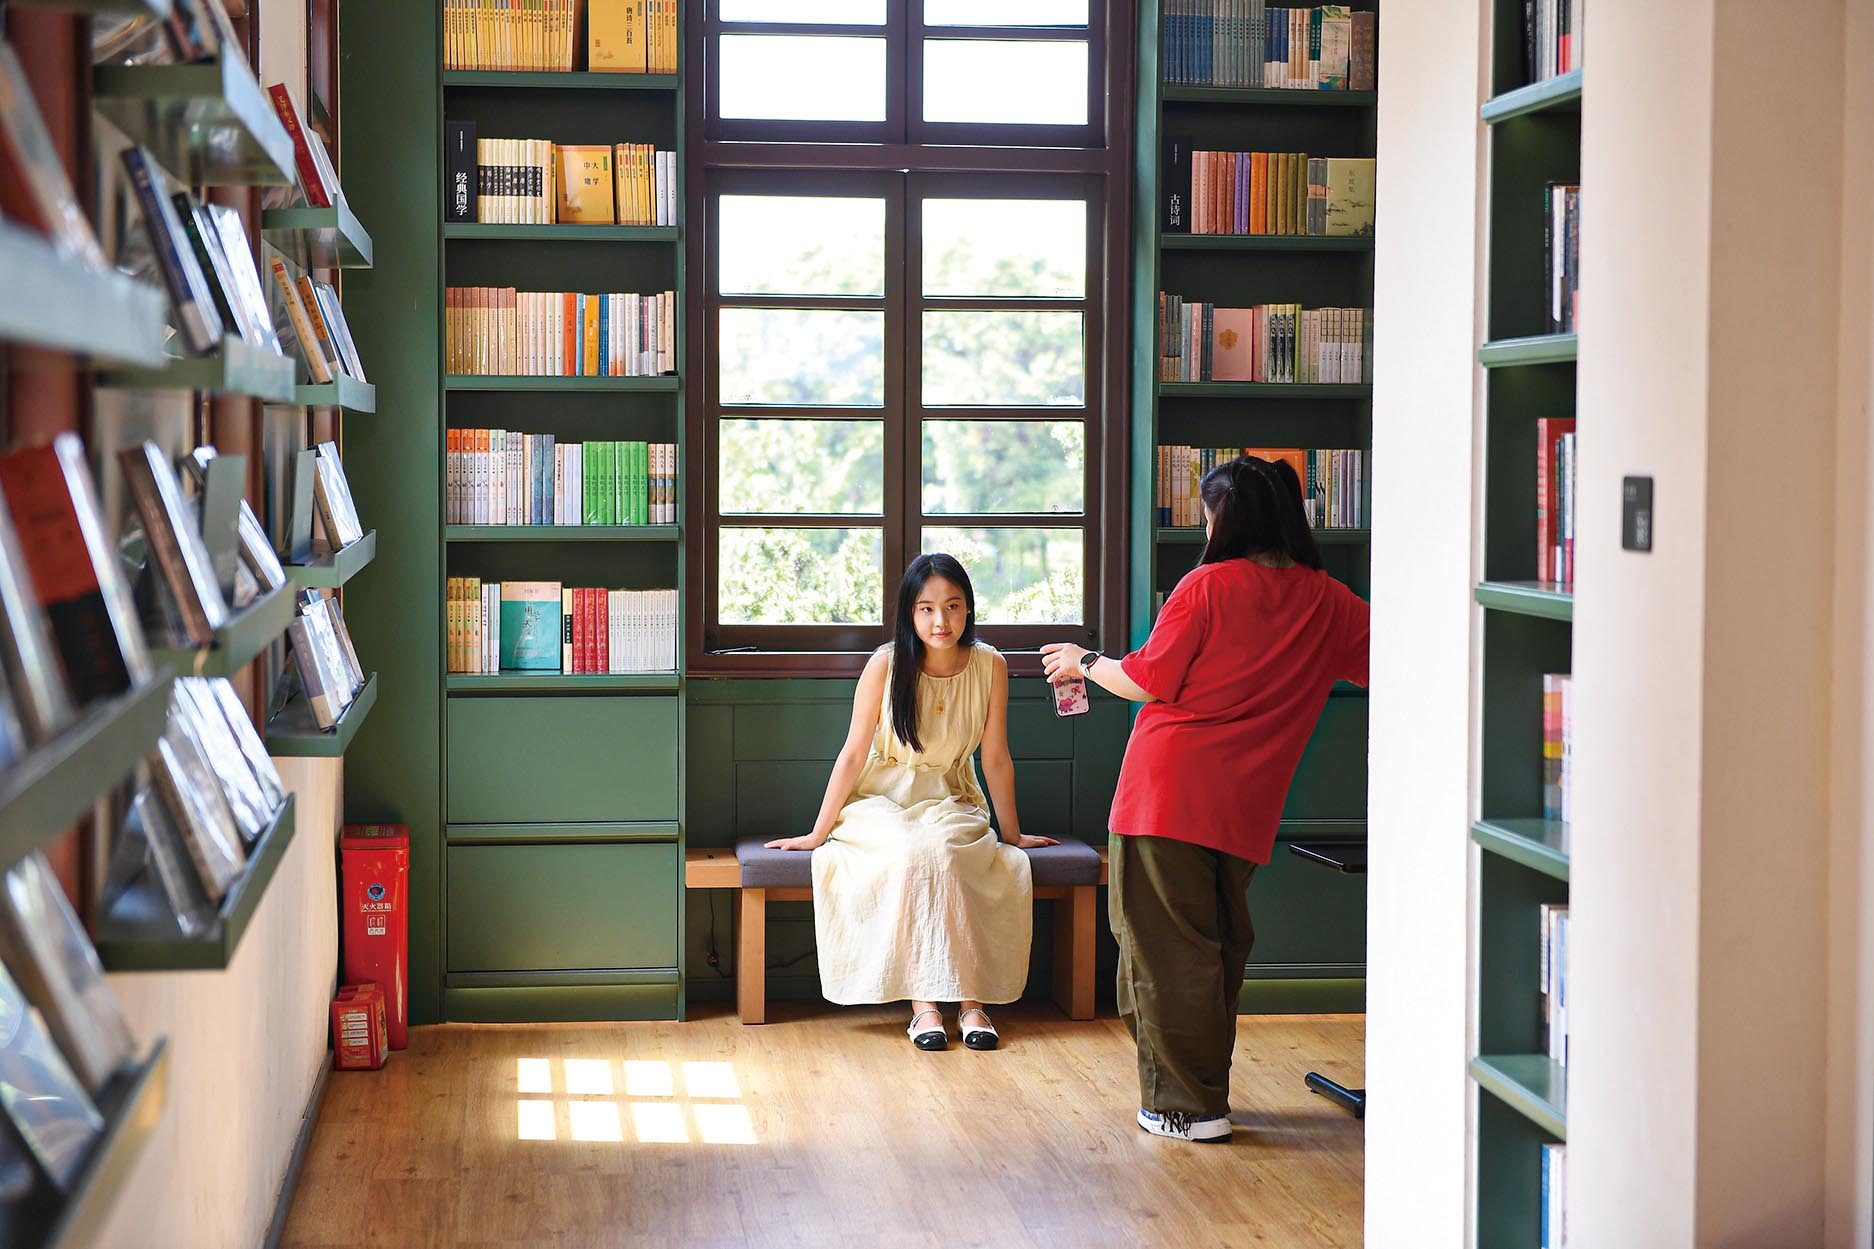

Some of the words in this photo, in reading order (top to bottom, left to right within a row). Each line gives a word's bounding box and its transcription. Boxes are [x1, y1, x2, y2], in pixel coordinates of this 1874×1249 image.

[455, 172, 468, 216] 经典国学
[1169, 194, 1181, 226] 古诗词
